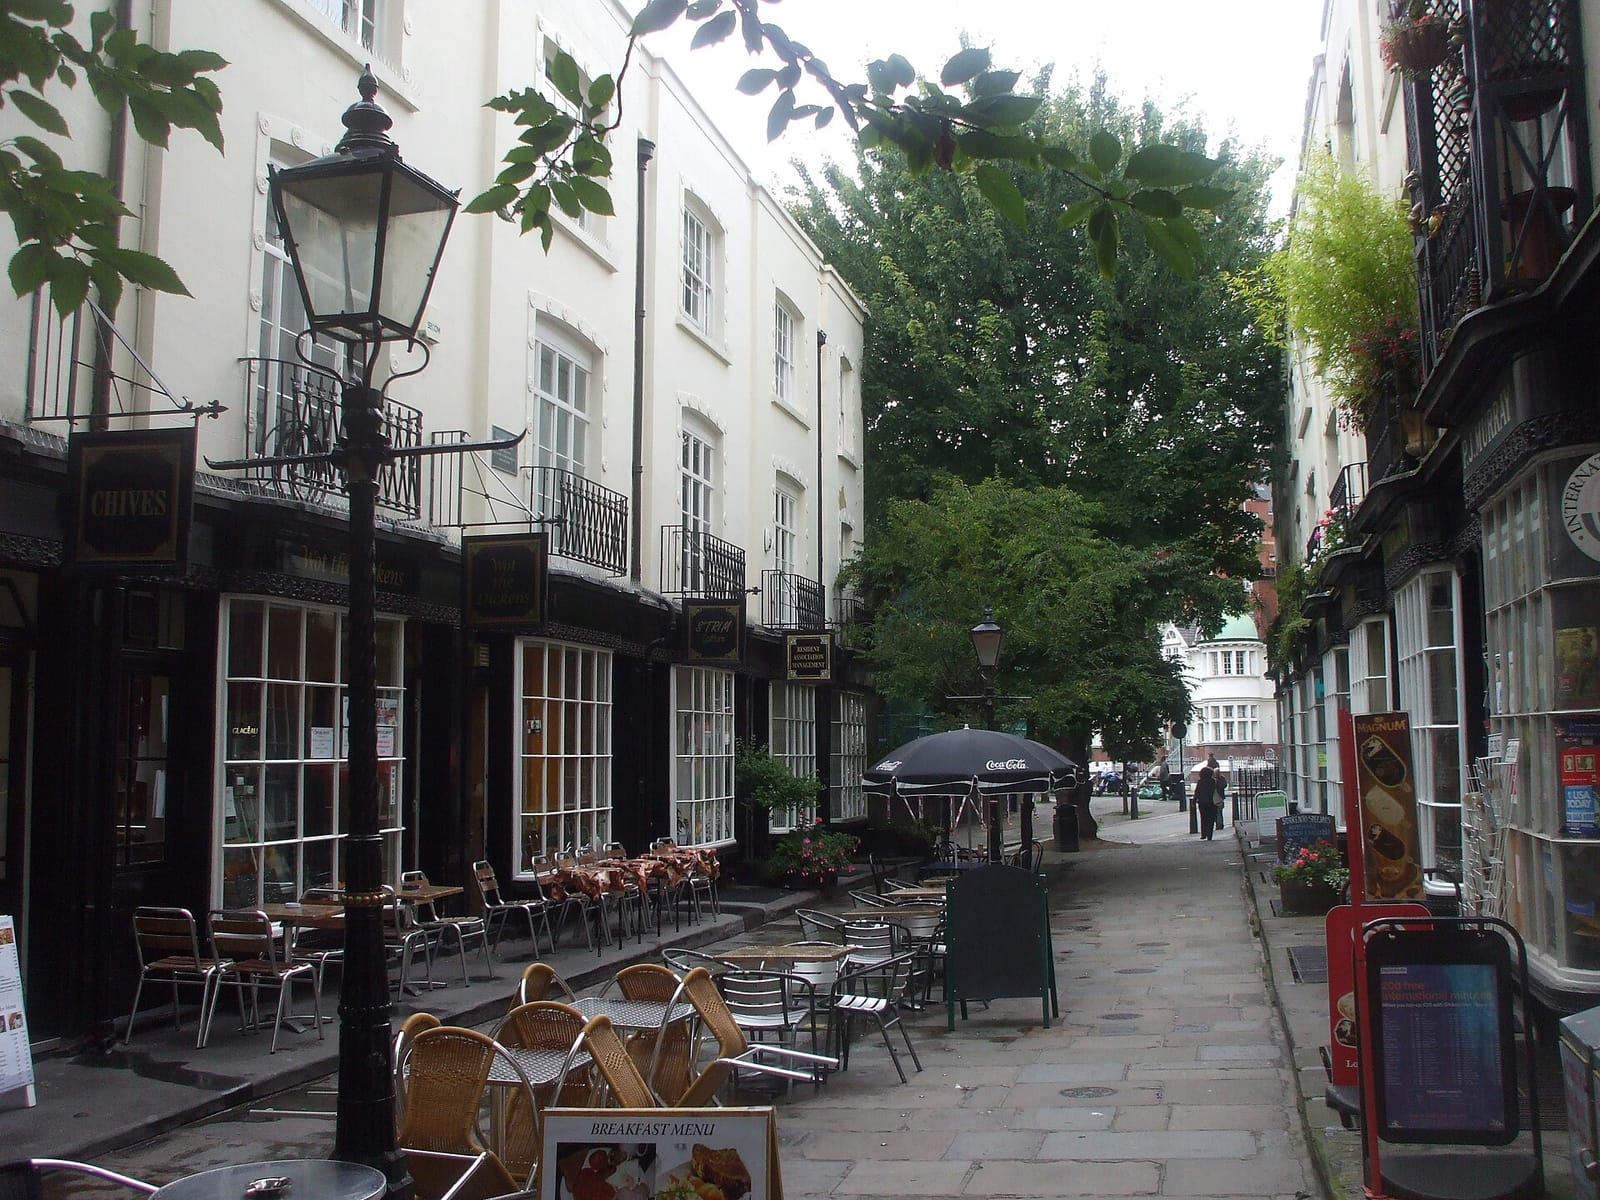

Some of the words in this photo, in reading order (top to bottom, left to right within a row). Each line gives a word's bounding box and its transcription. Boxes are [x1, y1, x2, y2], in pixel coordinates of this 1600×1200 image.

[91, 490, 167, 518] CHIVES
[1357, 720, 1407, 733] MAGNUM
[985, 759, 1026, 771] Coca-Cola
[1573, 790, 1591, 799] USA
[590, 1122, 670, 1136] BREAKFAST
[671, 1123, 716, 1136] MENU
